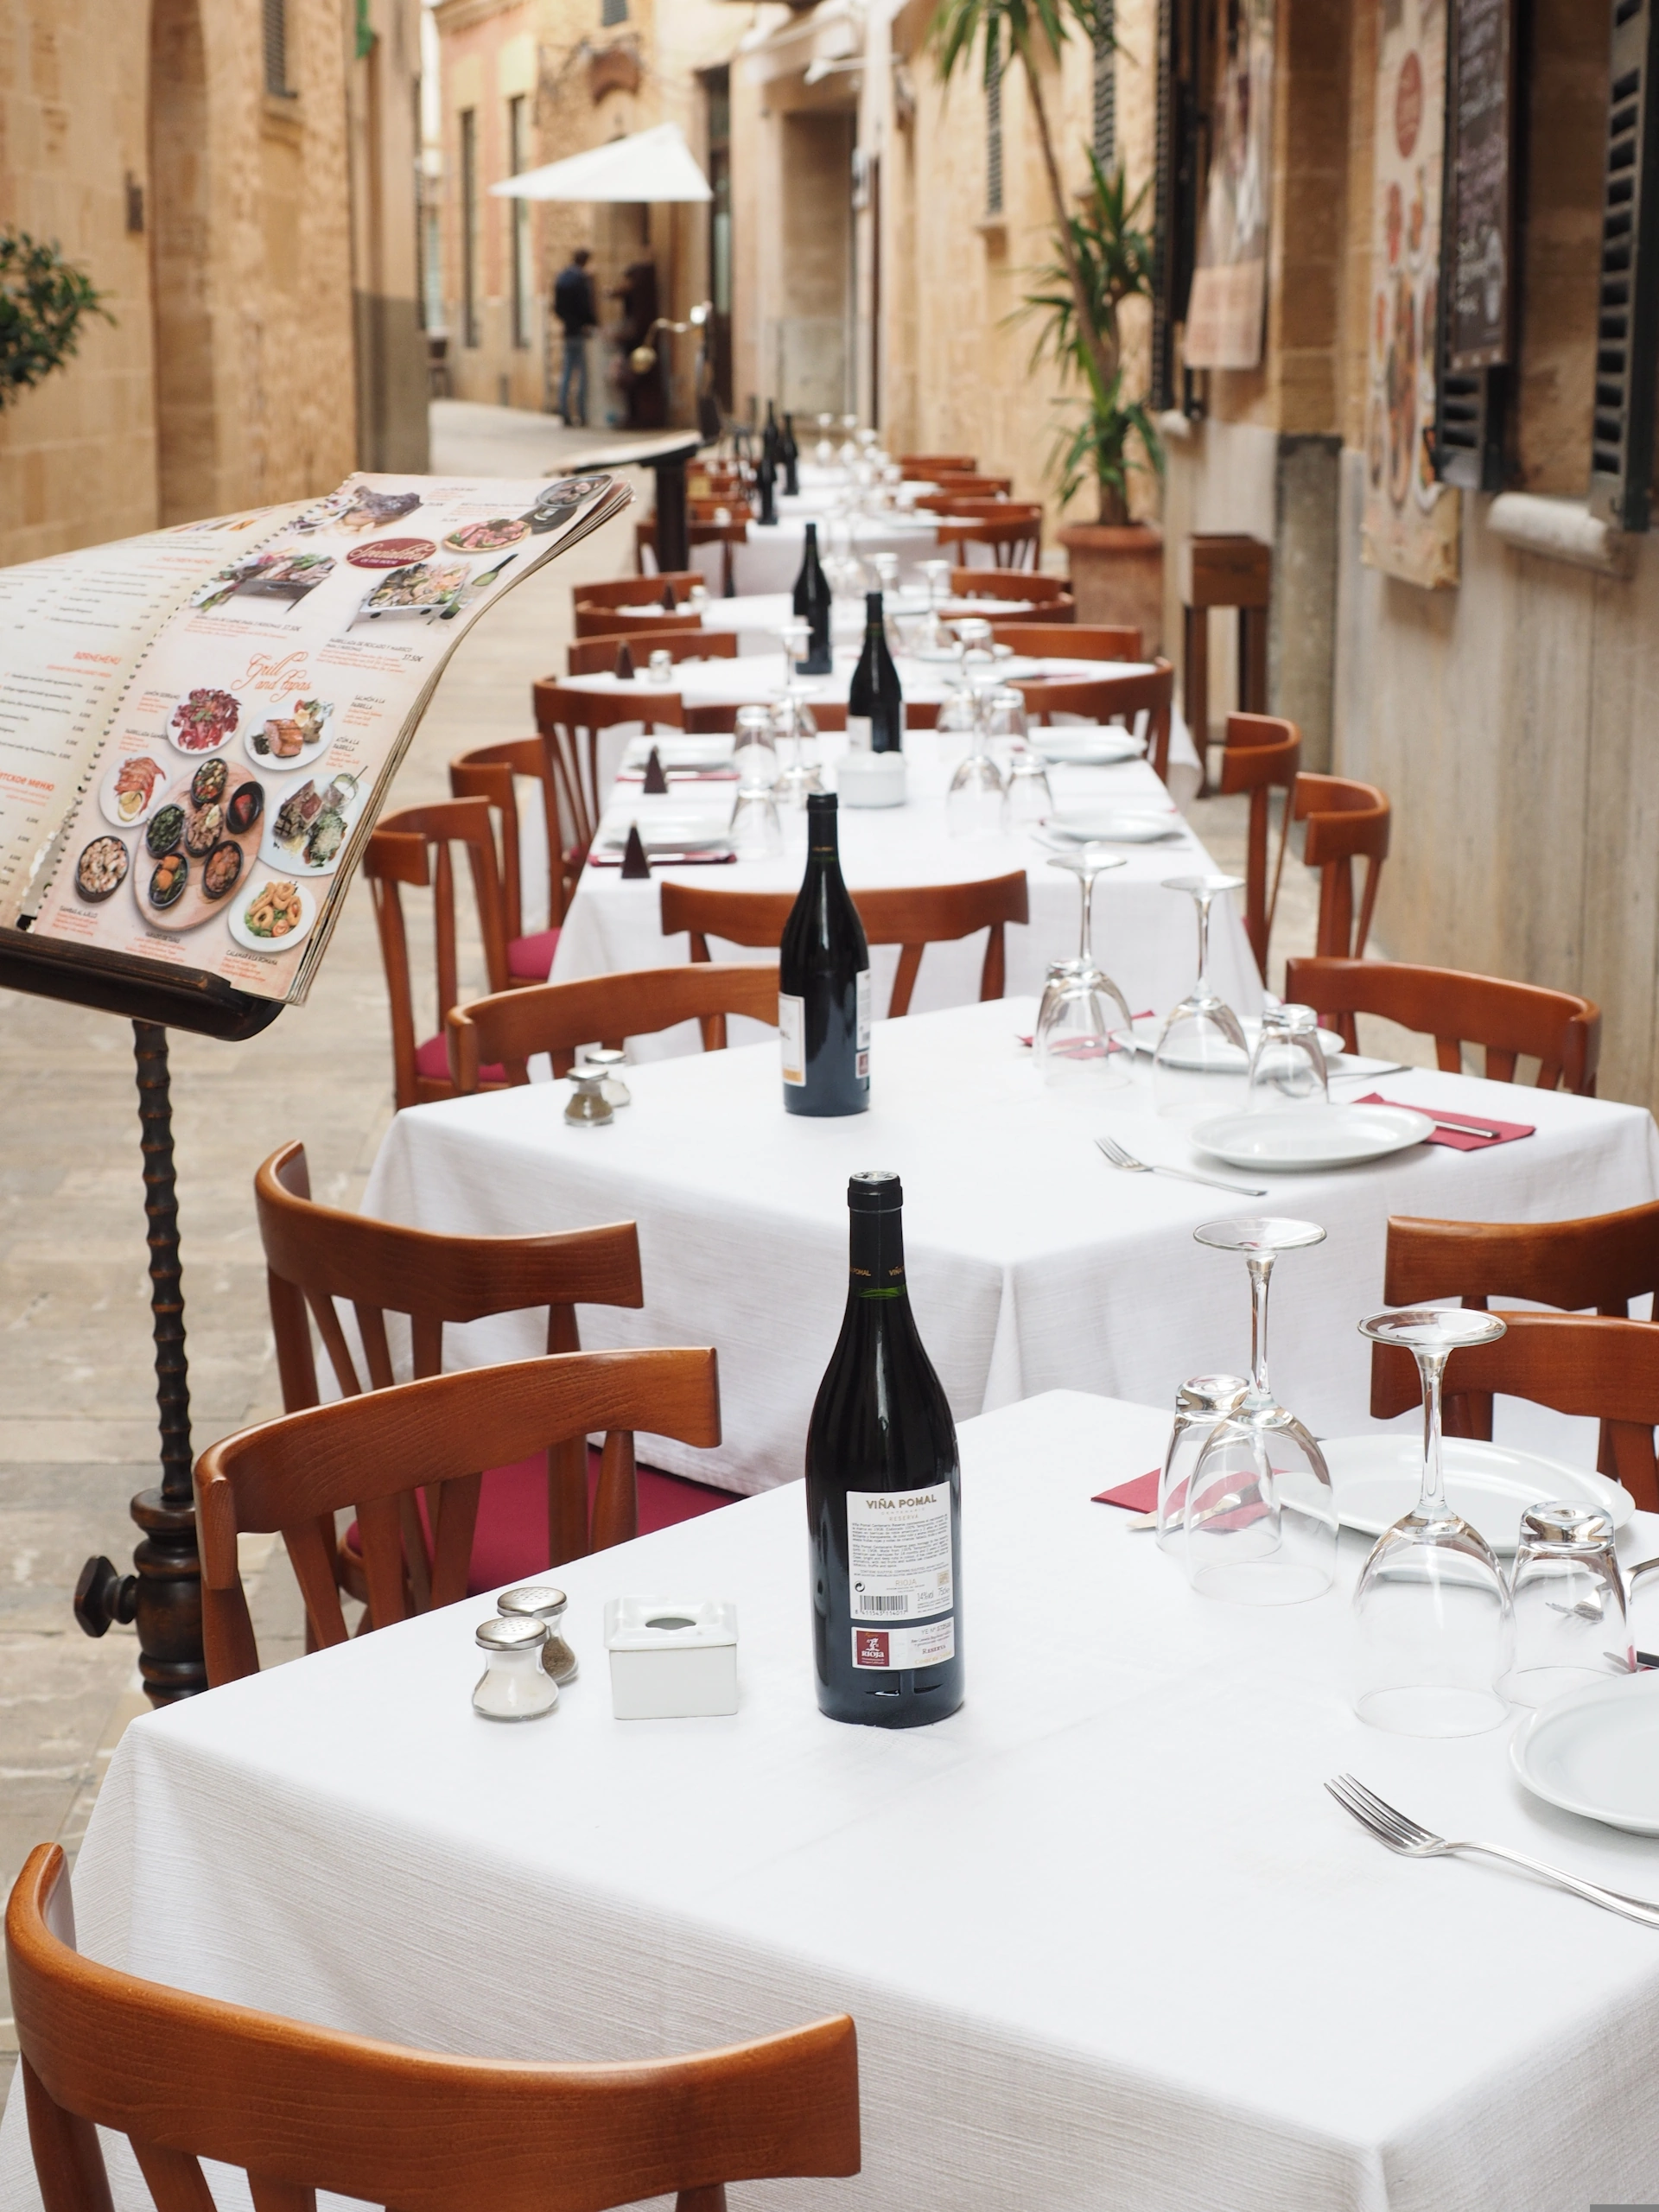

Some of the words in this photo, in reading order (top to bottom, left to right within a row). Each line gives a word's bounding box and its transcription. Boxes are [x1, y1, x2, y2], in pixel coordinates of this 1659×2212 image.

[230, 651, 308, 691] Grill
[866, 1498, 896, 1510] VIÑA
[899, 1494, 937, 1509] POMAL
